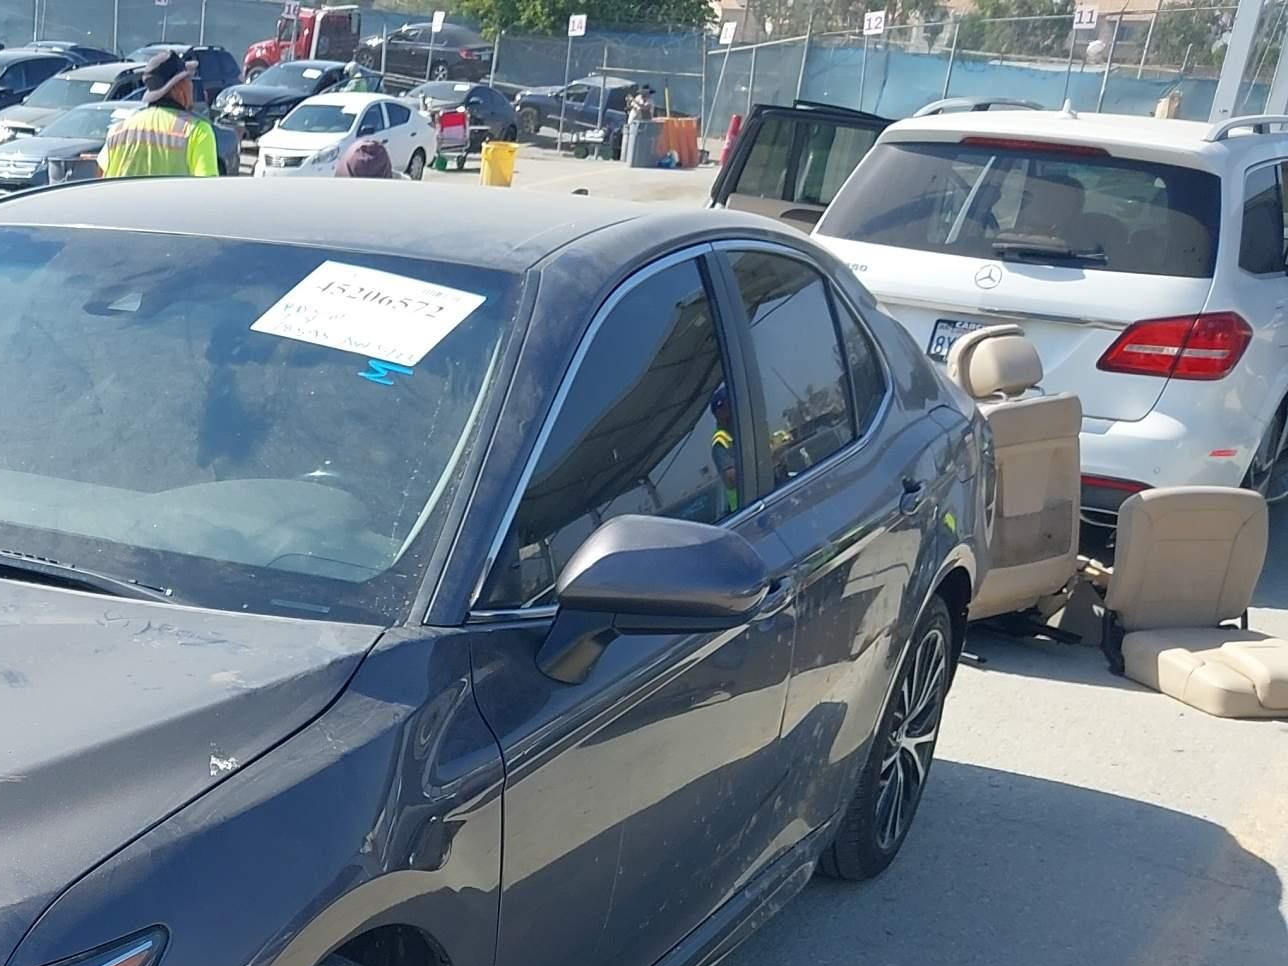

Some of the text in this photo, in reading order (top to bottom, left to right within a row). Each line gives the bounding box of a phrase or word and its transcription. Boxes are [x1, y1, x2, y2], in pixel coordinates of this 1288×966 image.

[864, 15, 883, 32] 12
[1076, 9, 1096, 25] 11
[317, 281, 445, 318] 45206572
